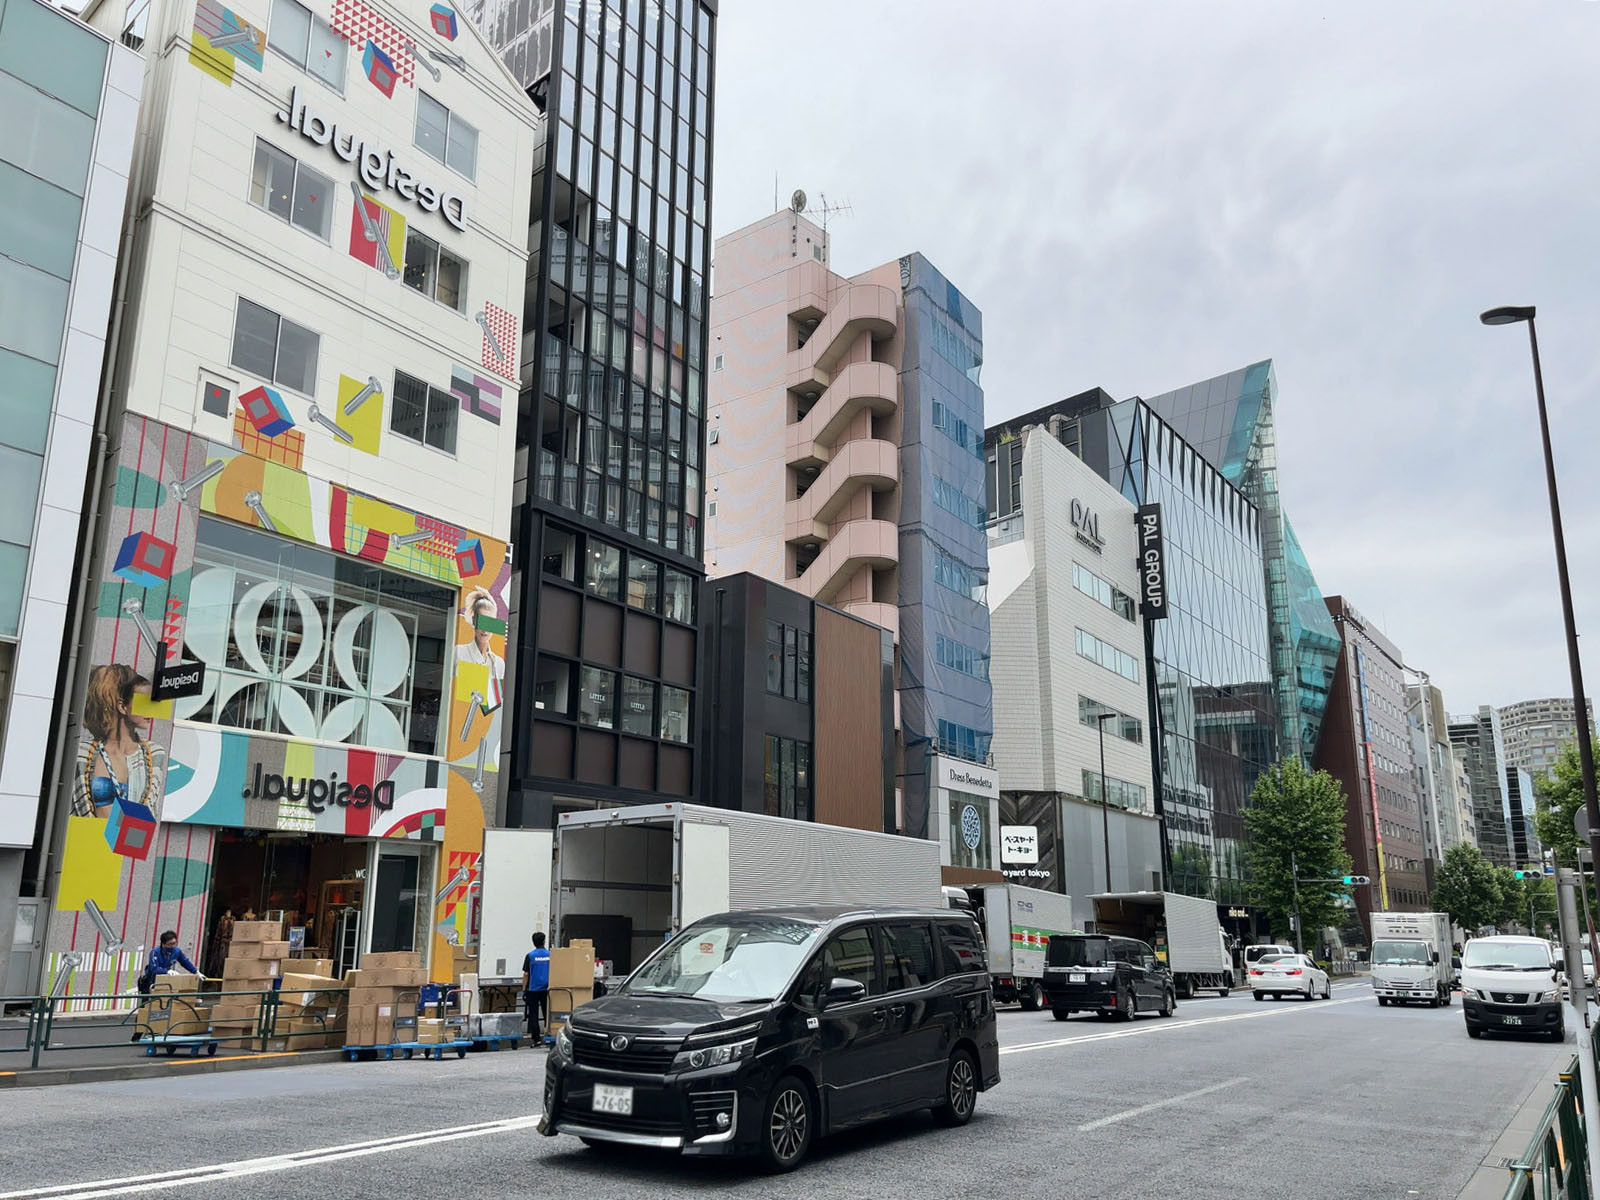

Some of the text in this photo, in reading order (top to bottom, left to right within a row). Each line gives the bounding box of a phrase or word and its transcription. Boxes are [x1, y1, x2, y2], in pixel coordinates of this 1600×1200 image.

[1070, 498, 1106, 546] PAL
[1143, 514, 1162, 608] PAL GROUP
[949, 768, 993, 789] Dress Benedetta
[1027, 868, 1050, 878] tokyo
